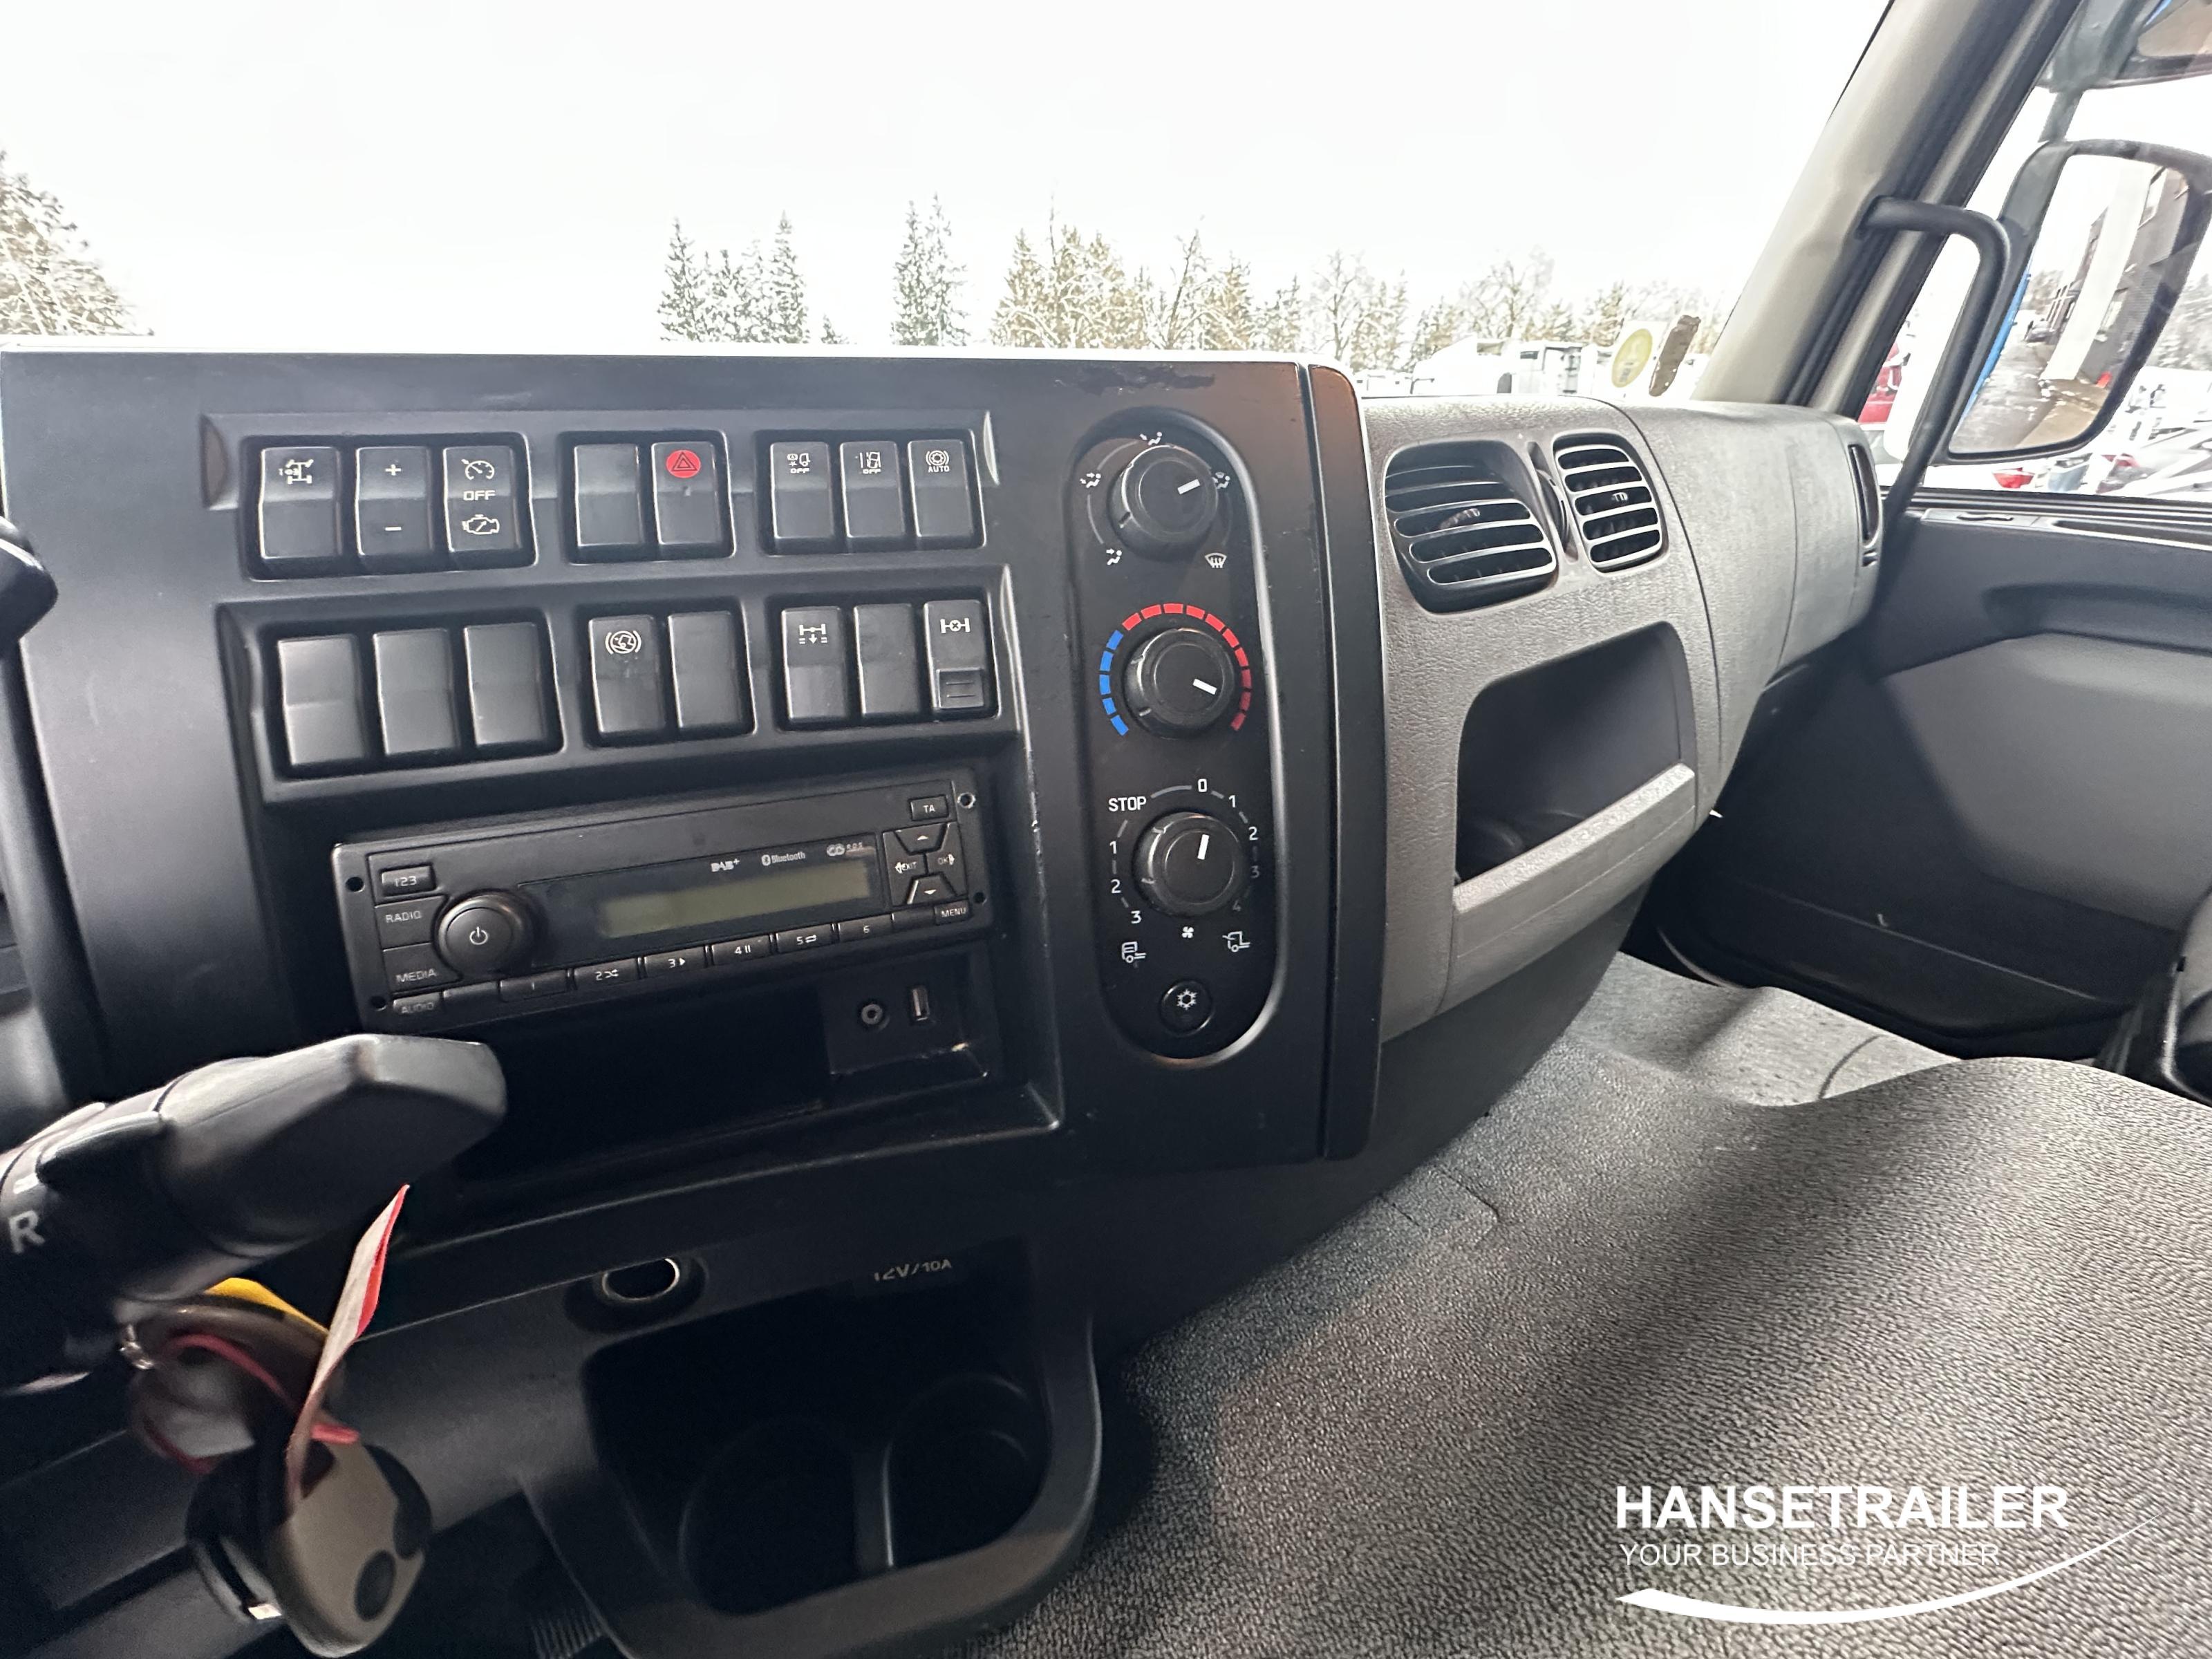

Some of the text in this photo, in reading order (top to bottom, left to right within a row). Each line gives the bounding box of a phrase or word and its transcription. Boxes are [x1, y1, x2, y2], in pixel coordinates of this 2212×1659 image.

[463, 489, 496, 501] OFF
[1197, 778, 1208, 792] 0
[1108, 796, 1147, 812] STOP
[1228, 795, 1236, 807] 1
[923, 804, 935, 813] TA
[1248, 826, 1259, 841] 2
[1109, 841, 1117, 854] 1
[771, 851, 806, 864] Bluetooth
[901, 861, 917, 871] EXIT
[1250, 865, 1260, 878] 3
[395, 875, 418, 888] 123
[1111, 879, 1121, 894] 2
[1232, 899, 1241, 912] 4
[385, 910, 422, 924] RADIO
[941, 907, 966, 918] MENU
[1130, 910, 1142, 924] 3
[863, 925, 870, 934] 6
[796, 936, 803, 945] 5
[734, 945, 742, 955] 4
[668, 958, 675, 968] 3
[395, 968, 437, 982] MEDIA
[595, 971, 603, 980] 2
[400, 1002, 435, 1014] AUDIO
[8, 1210, 45, 1255] R
